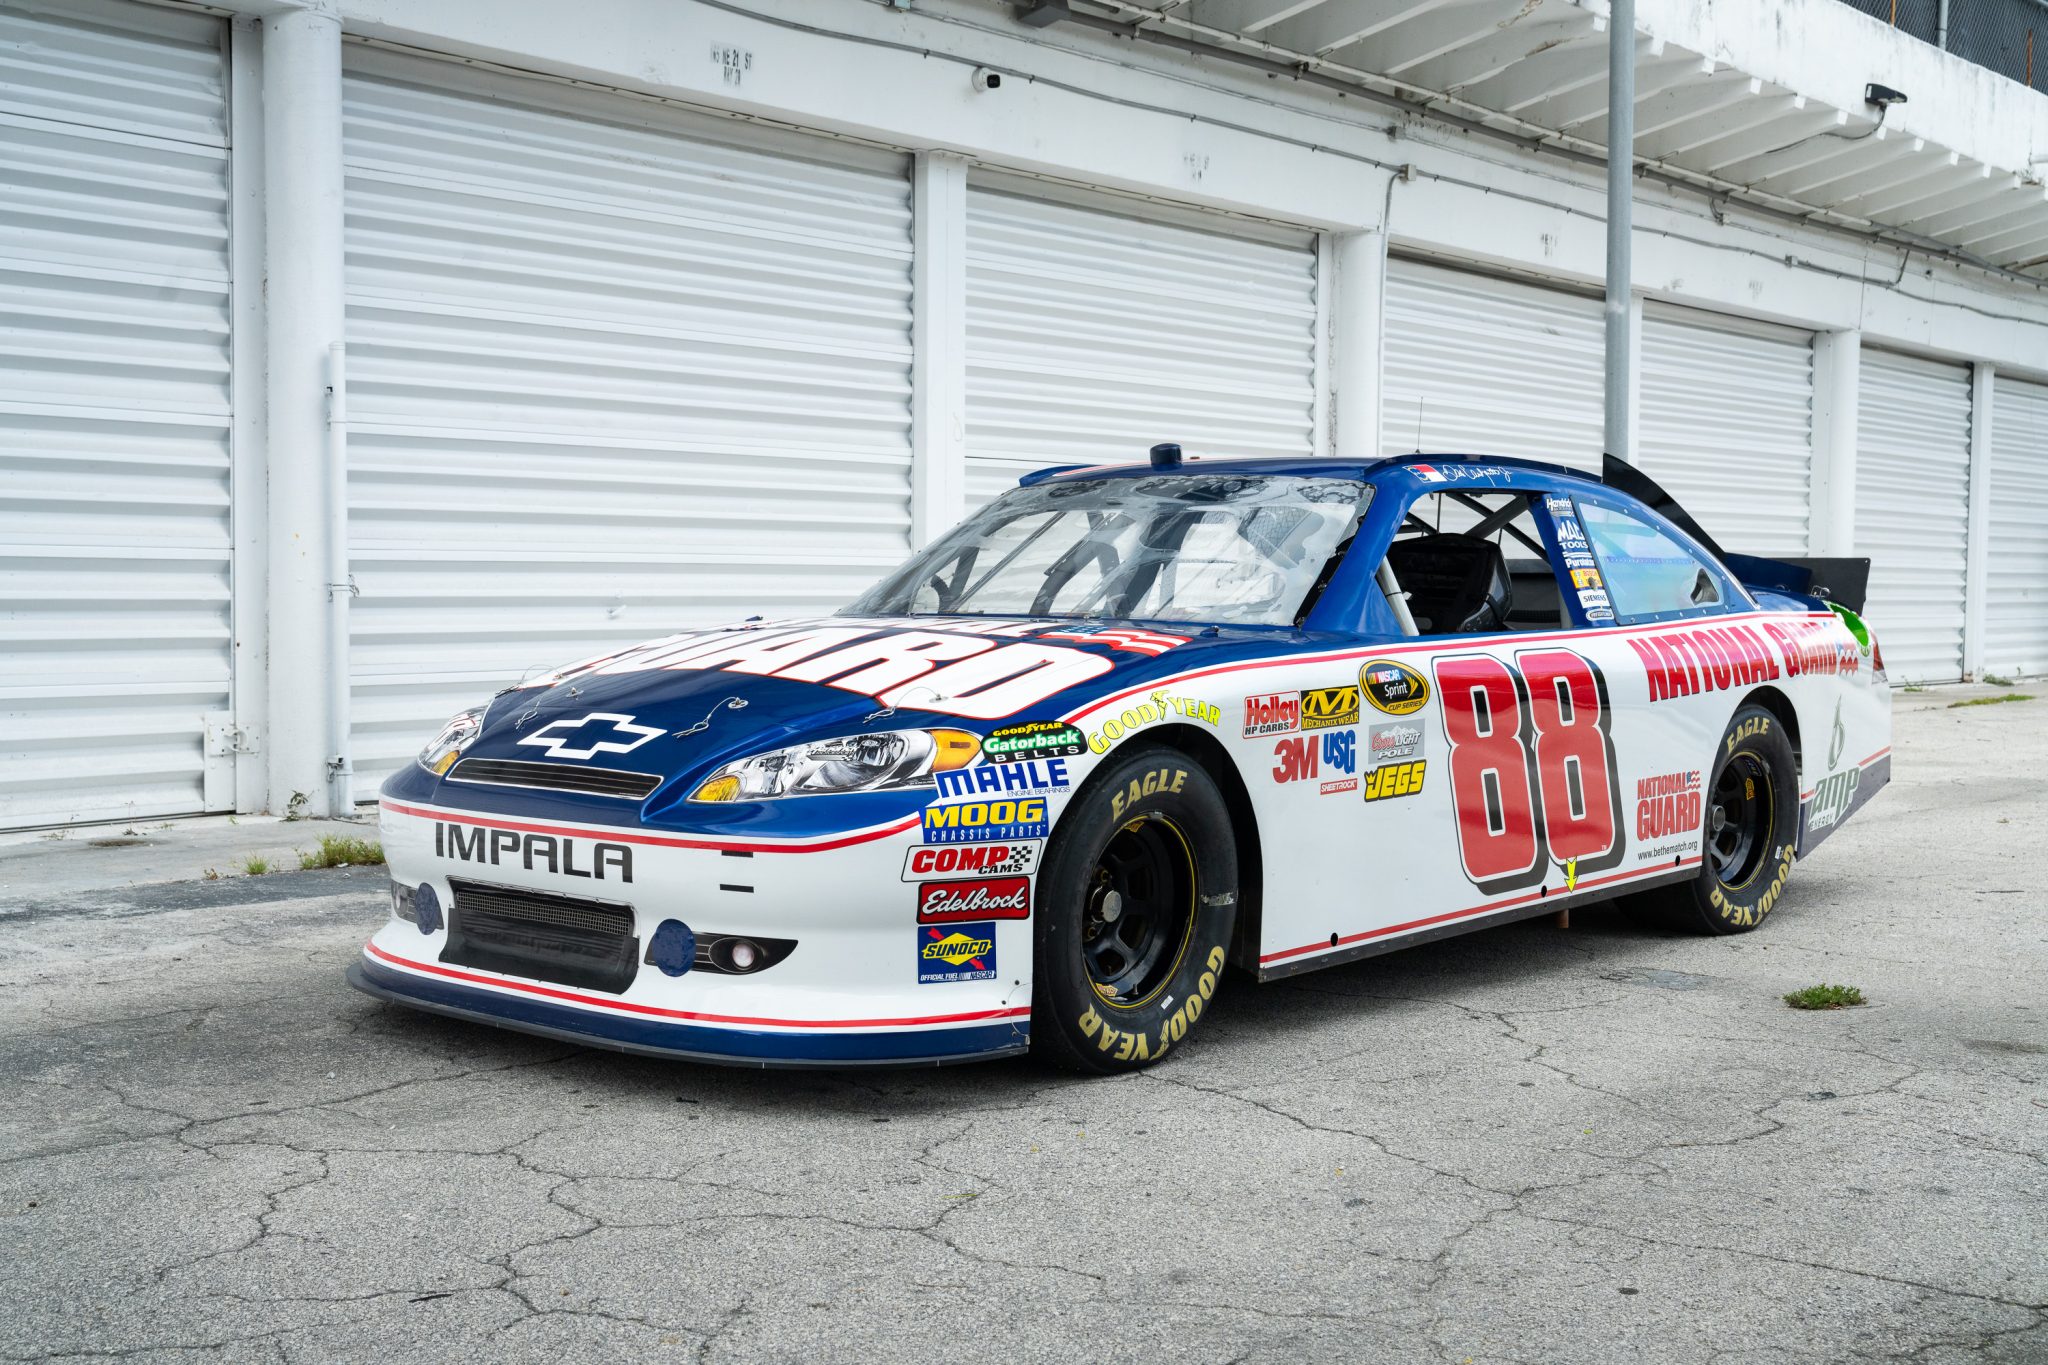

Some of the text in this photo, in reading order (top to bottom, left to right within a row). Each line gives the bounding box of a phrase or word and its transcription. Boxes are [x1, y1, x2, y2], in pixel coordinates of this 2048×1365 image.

[732, 49, 739, 67] 21
[744, 52, 753, 71] ST
[1559, 540, 1589, 550] TOOLS
[1583, 594, 1607, 602] SIEMENS
[1627, 624, 1780, 702] NATIONAL
[1377, 669, 1402, 684] NASCAR
[1384, 681, 1408, 700] Sprint
[1245, 695, 1299, 730] Holley
[1388, 700, 1423, 712] CUP SERIES
[1245, 721, 1290, 735] HP CARBS
[1338, 712, 1359, 725] WEAR
[983, 730, 1080, 754] Gatorback
[1394, 731, 1421, 747] LIGHT
[1726, 717, 1770, 753] EAGLE
[994, 745, 1080, 763] BELTS
[1272, 735, 1319, 784] 3M
[1323, 730, 1356, 774] USG
[1377, 746, 1413, 760] POLE
[937, 758, 1070, 799] MAHLE
[1432, 648, 1622, 893] 88
[1320, 780, 1357, 793] SHEETROCK
[1366, 761, 1426, 801] JEGS
[1637, 771, 1688, 800] NATIONAL
[1006, 786, 1071, 798] ENGINE BEARINGS
[1111, 768, 1188, 822] EAGLE
[924, 799, 1044, 829] MOOG
[1636, 791, 1701, 842] GUARD
[1809, 813, 1836, 831] ENERGY
[931, 825, 1041, 842] CHASSIS PARTS
[435, 822, 634, 884] IMPALA
[911, 846, 1009, 874] COMP
[1637, 840, 1698, 860] www.bethematch.org
[978, 863, 1024, 875] CAMS
[922, 886, 1026, 915] Edelbrock
[925, 940, 989, 957] SUNOCO
[945, 972, 959, 980] FUEL
